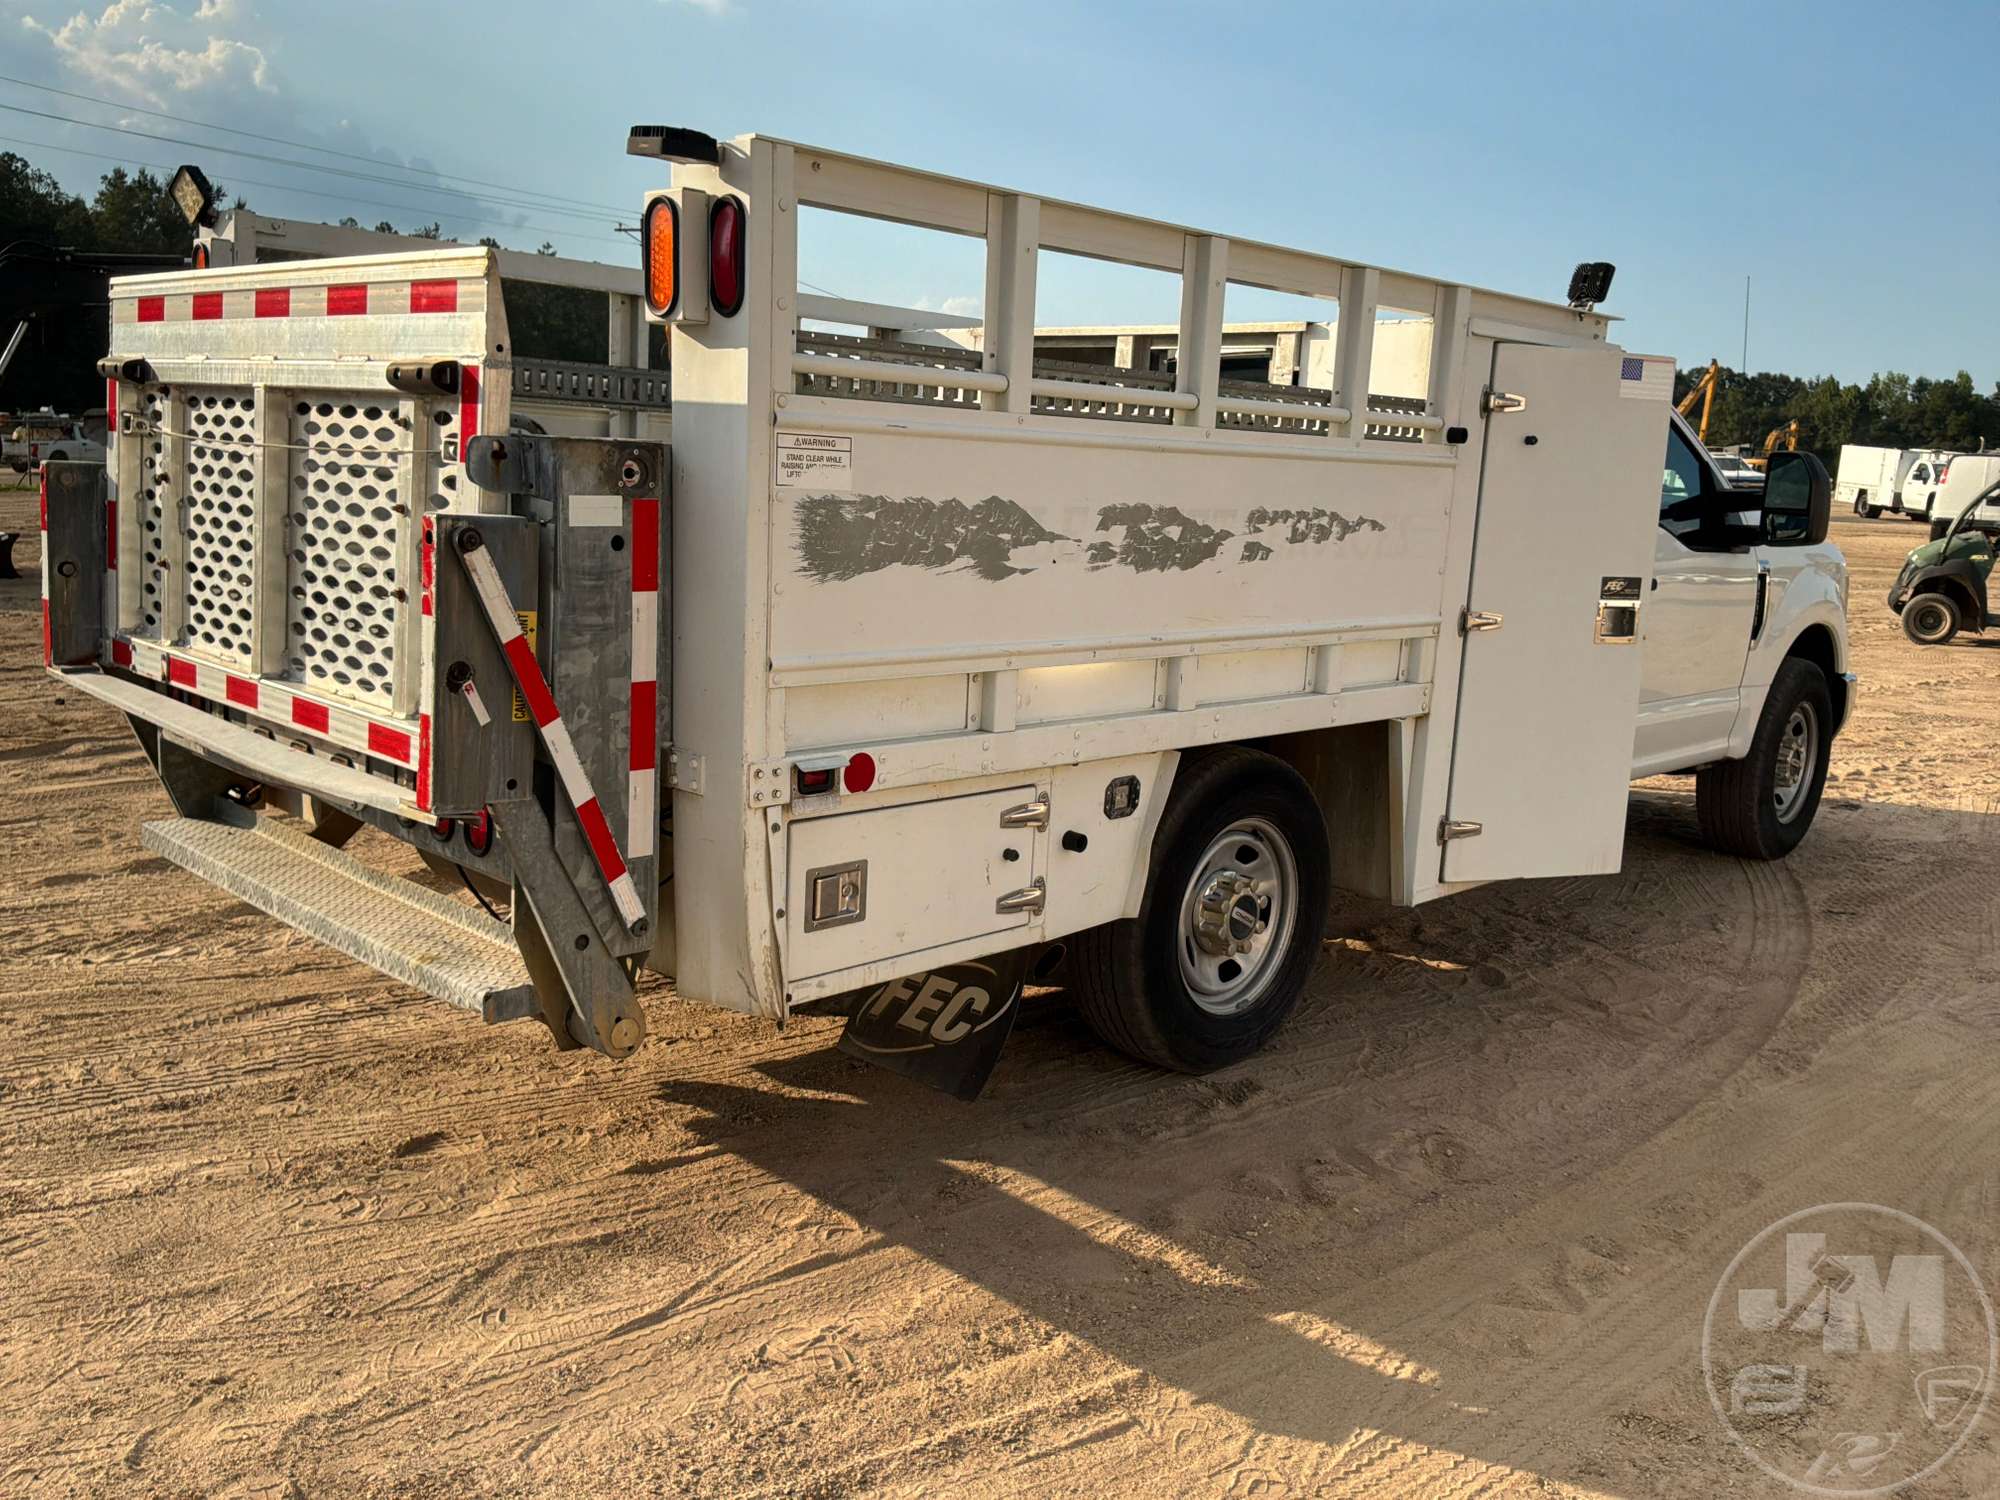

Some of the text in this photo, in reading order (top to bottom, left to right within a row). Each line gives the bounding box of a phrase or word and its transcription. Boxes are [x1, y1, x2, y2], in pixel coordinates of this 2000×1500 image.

[801, 438, 836, 448] WARNING
[786, 454, 842, 464] STAND CLEAR WHILE
[781, 461, 804, 470] RAISING
[866, 971, 990, 1042] FEC
